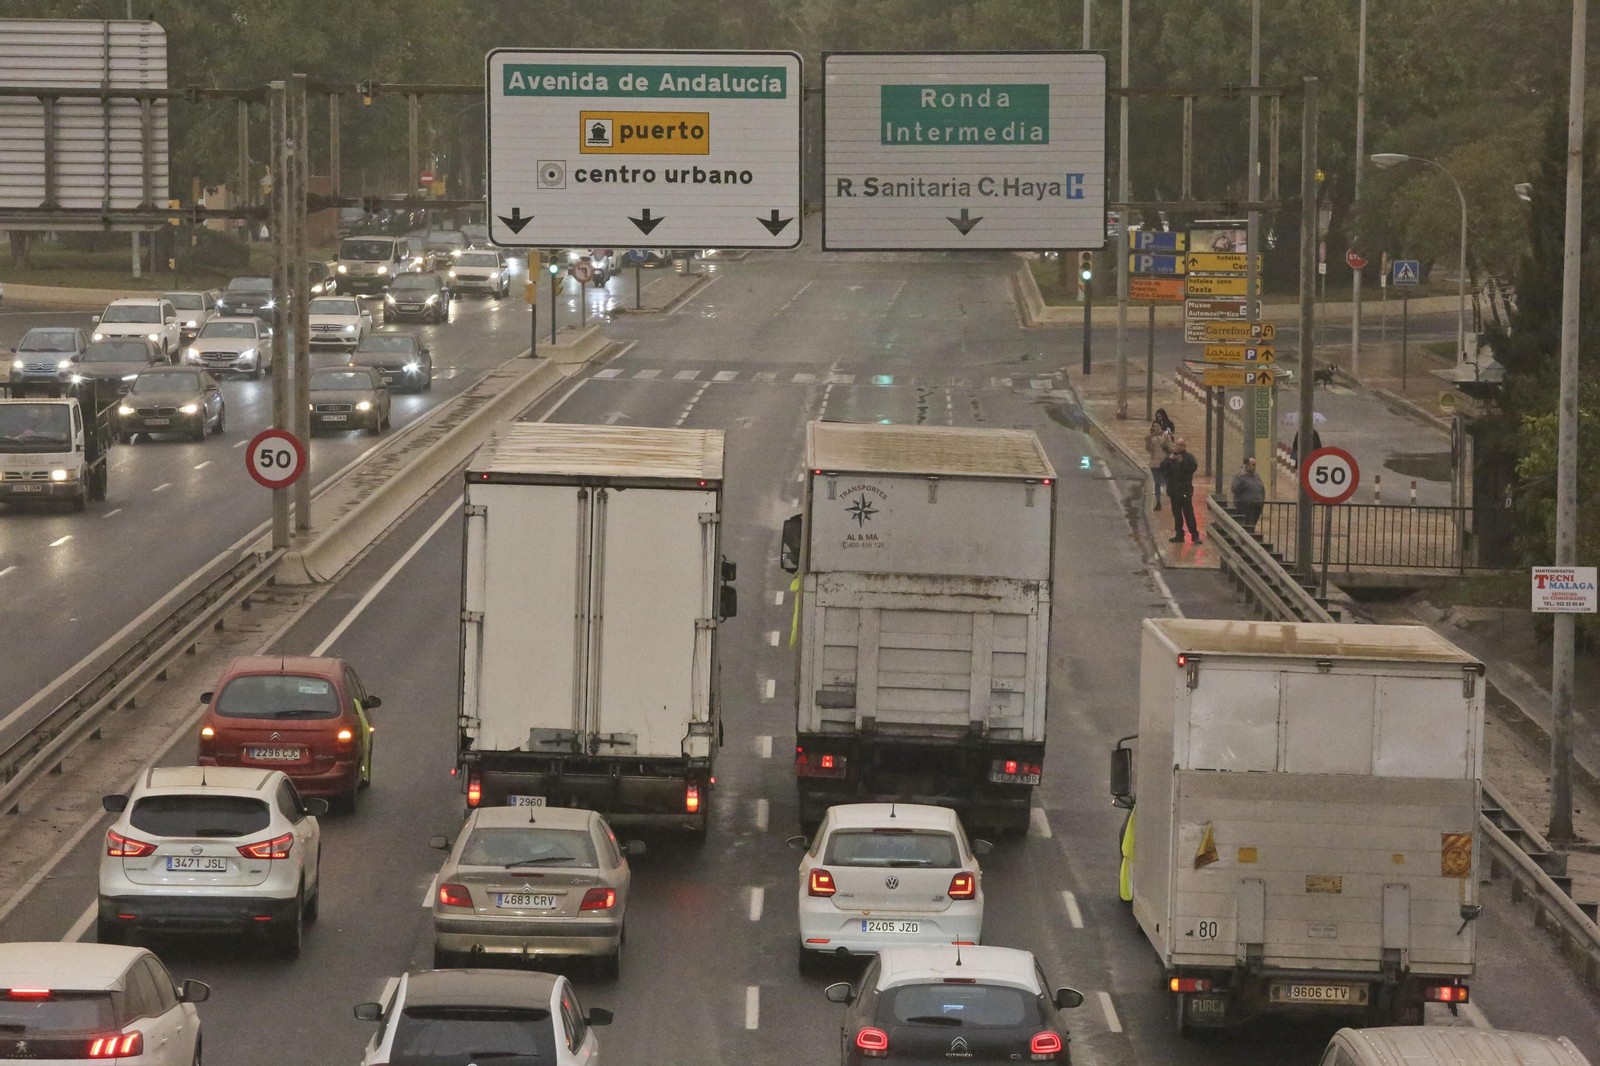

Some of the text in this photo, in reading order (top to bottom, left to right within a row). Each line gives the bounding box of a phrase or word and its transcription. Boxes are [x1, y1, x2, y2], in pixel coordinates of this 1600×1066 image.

[508, 71, 782, 93] Avenida de Andalucía
[921, 88, 1010, 108] Ronda
[620, 121, 704, 143] puerto
[886, 121, 1043, 141] Intermedia
[574, 165, 753, 184] centro urbano
[1141, 233, 1154, 249] P
[1140, 256, 1154, 272] P
[1205, 326, 1250, 336] Carrefour
[1247, 350, 1255, 359] P
[1246, 373, 1255, 383] P
[1231, 398, 1241, 407] 11
[260, 449, 291, 469] 50
[1315, 466, 1346, 485] 50
[839, 484, 888, 500] TRANSPORTES
[1534, 574, 1574, 589] TECNI
[1549, 582, 1594, 590] MALAGA
[256, 748, 299, 758] 2296 CJC
[519, 797, 543, 807] 2960
[174, 859, 224, 868] 3471 JSL
[503, 895, 554, 906] 4683 CRV
[868, 922, 918, 932] 2405 JZD
[1199, 921, 1217, 938] 80
[1293, 987, 1347, 998] 9606 CTV
